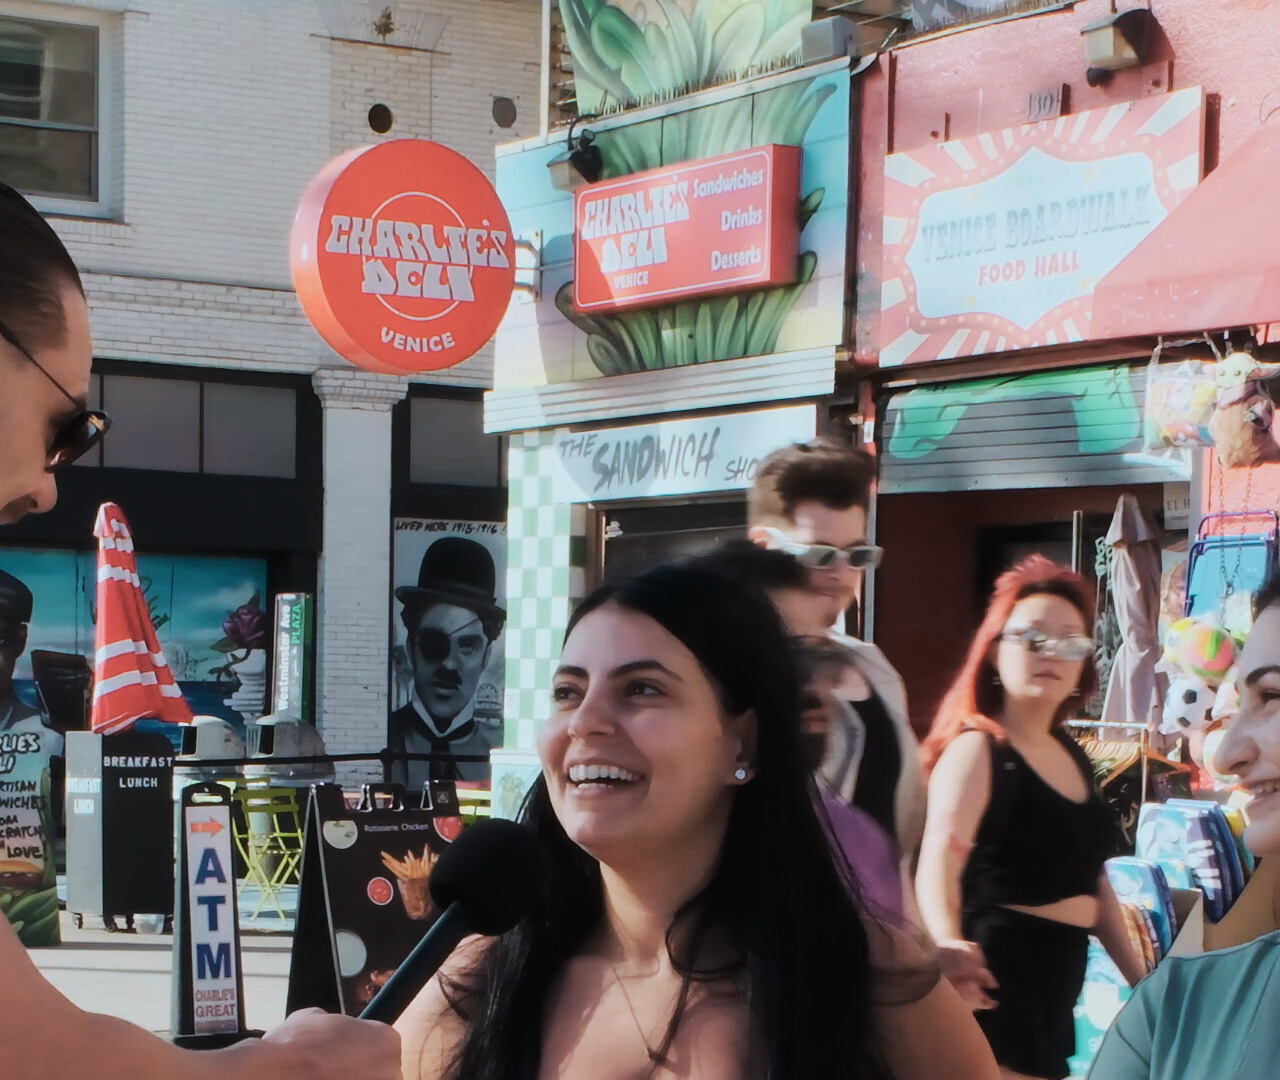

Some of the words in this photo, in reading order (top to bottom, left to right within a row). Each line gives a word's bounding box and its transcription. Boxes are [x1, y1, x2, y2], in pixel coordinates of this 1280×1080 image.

[693, 168, 763, 198] Sandwiches
[581, 174, 689, 240] CHARLIE'S
[721, 205, 762, 231] Drinks
[921, 213, 997, 263] VENICE
[1005, 184, 1151, 248] BOARDWALK
[325, 214, 509, 268] CHARLIE'S
[600, 227, 668, 274] DELI
[711, 246, 761, 272] Desserts
[978, 259, 1025, 286] FOOD
[1034, 250, 1080, 278] HALL
[361, 259, 475, 302] DELI
[614, 271, 649, 289] VENICE
[380, 326, 456, 353] VENICE
[559, 433, 598, 458] THE
[592, 426, 720, 493] SANDWICH
[724, 455, 759, 482] SHO
[395, 521, 422, 532] LIVED
[424, 522, 449, 532] HERE
[280, 604, 291, 629] Ave
[291, 604, 301, 644] PLAZA
[278, 631, 290, 711] Westminster
[104, 756, 174, 768] BREAKFAST
[119, 777, 158, 788] LUNCH
[194, 848, 232, 980] ATM
[195, 1003, 236, 1018] GREAT
